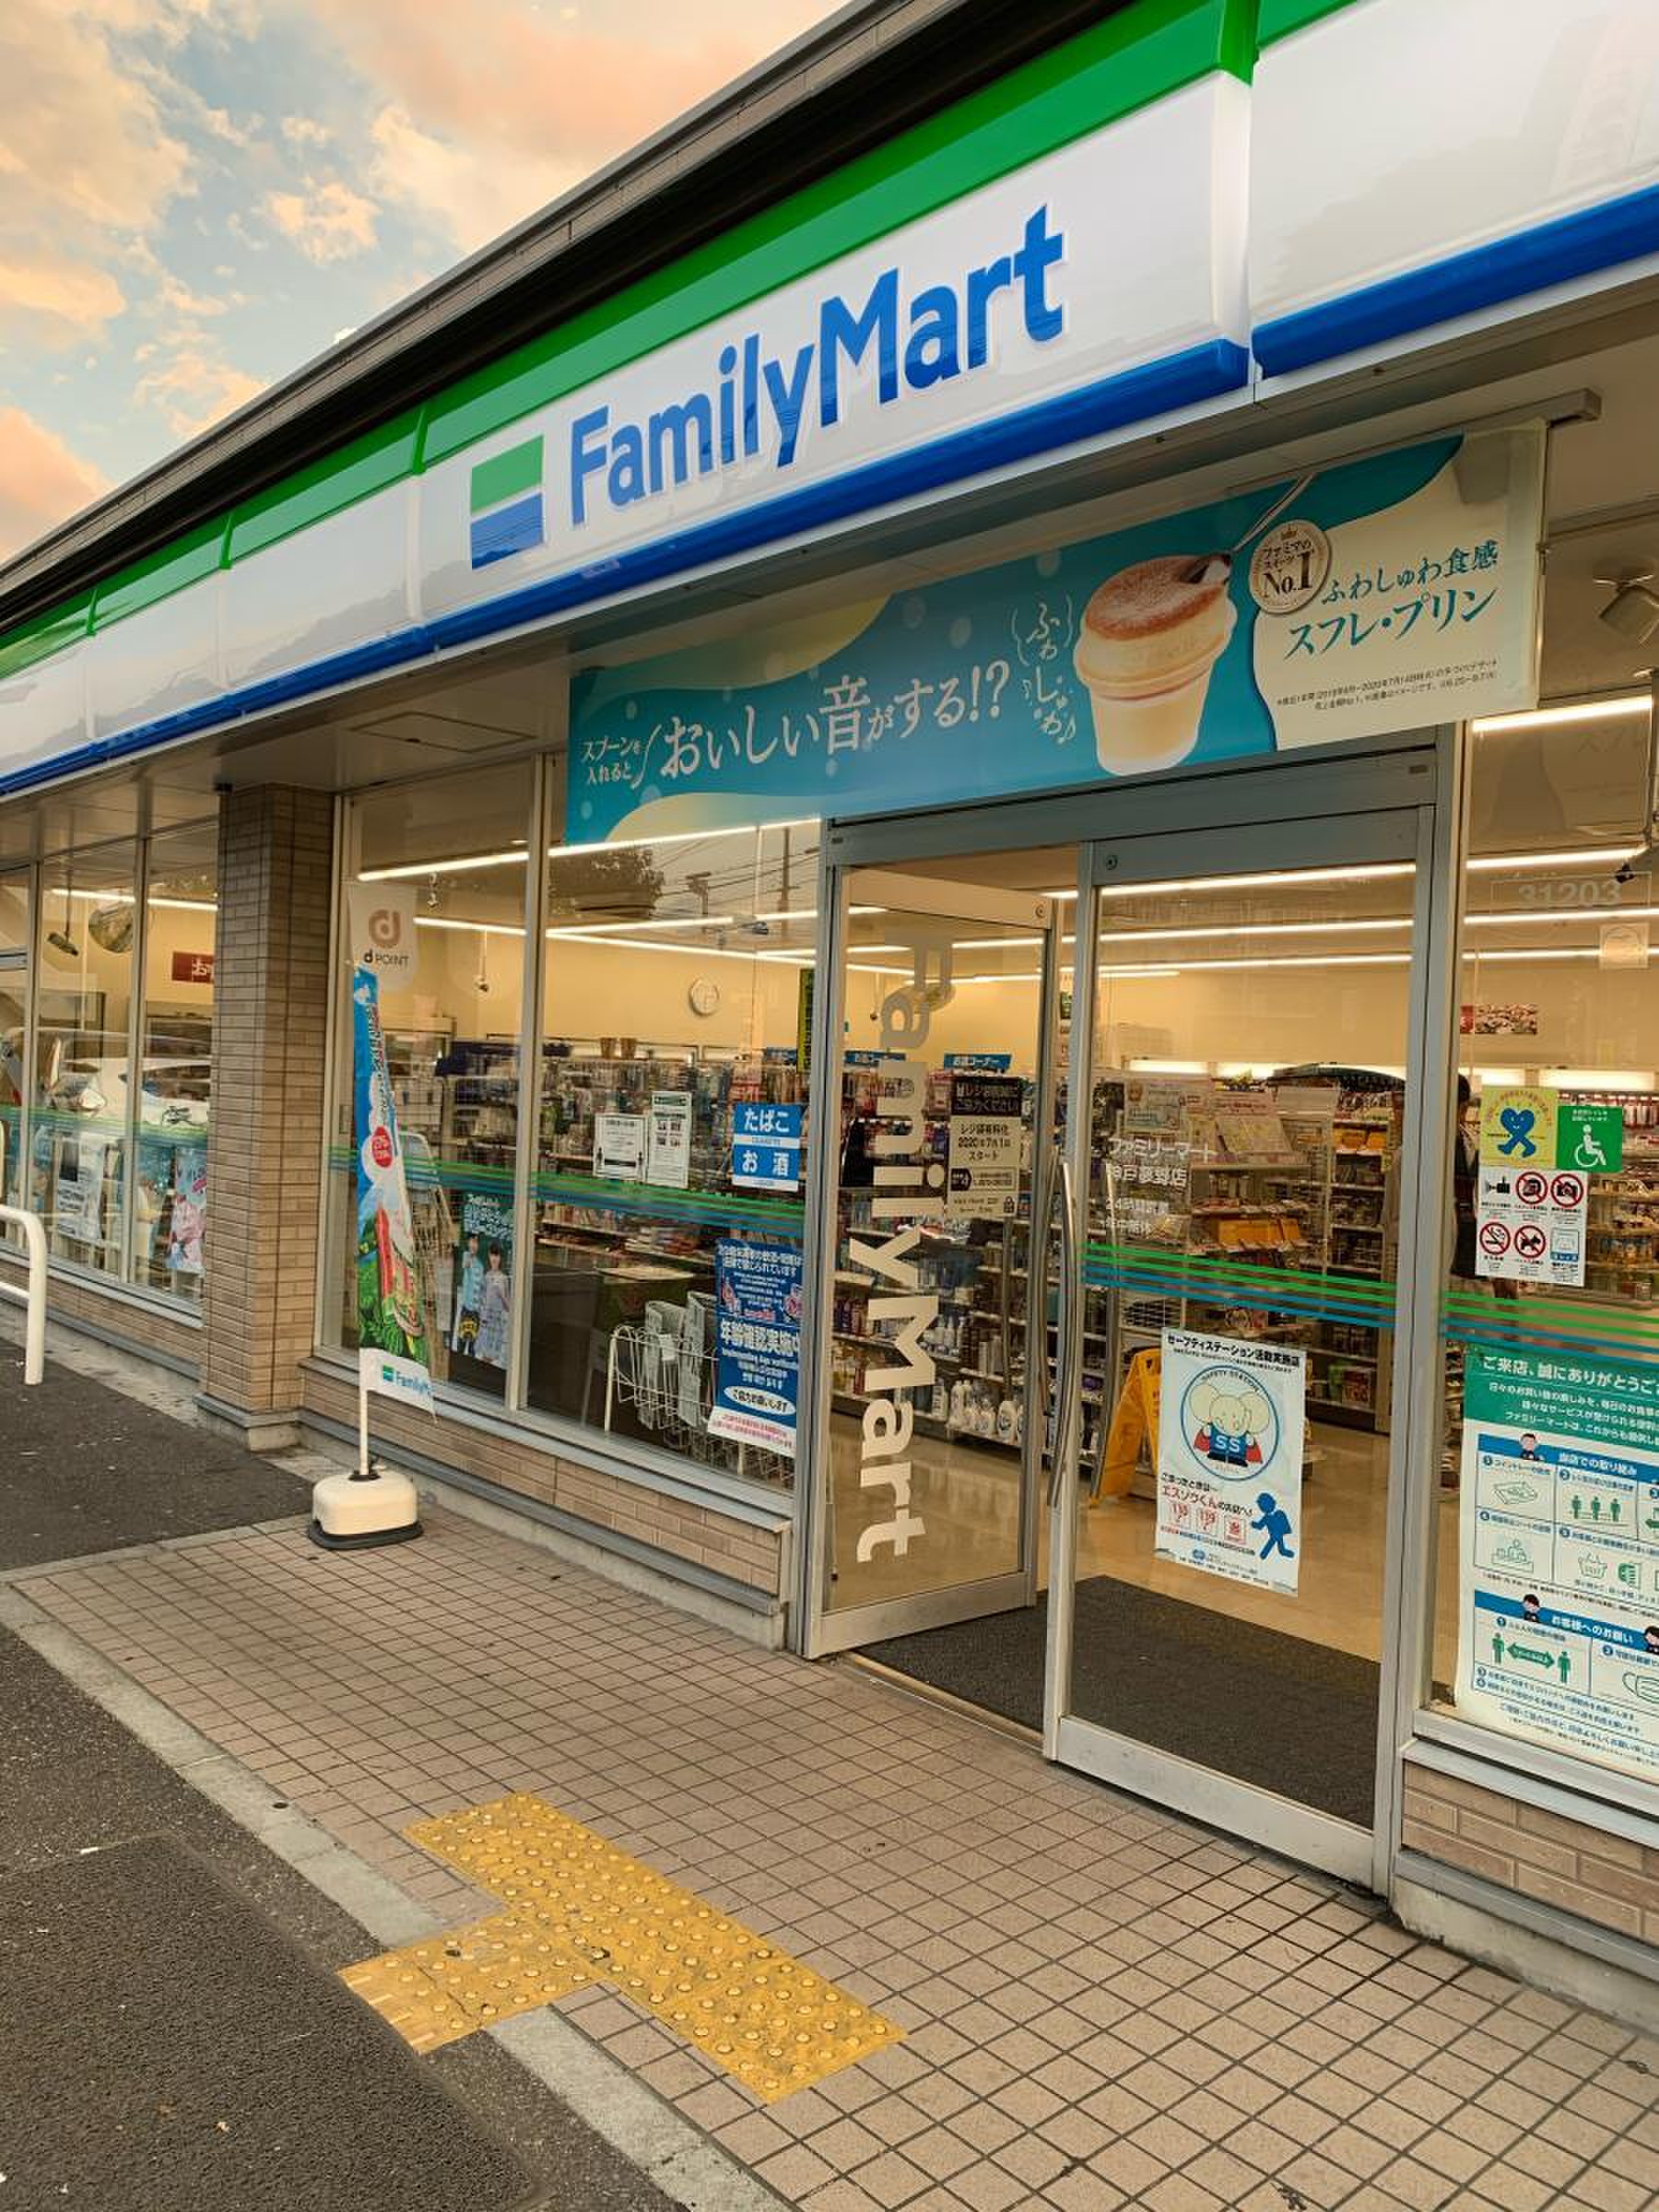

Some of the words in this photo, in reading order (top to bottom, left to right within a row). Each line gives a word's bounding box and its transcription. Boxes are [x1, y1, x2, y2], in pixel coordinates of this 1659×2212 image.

[571, 203, 1065, 525] FamilyMart
[1321, 538, 1499, 606] ふわしゅわ食感
[1283, 588, 1500, 662] スフレ・プリン
[375, 954, 409, 967] POINT
[744, 1107, 790, 1134] たばこ
[742, 1149, 790, 1177] お酒
[848, 920, 956, 1564] FamilyMart
[1482, 1356, 1659, 1394] ご来店、誠にありがとうご
[1214, 1433, 1242, 1454] SS
